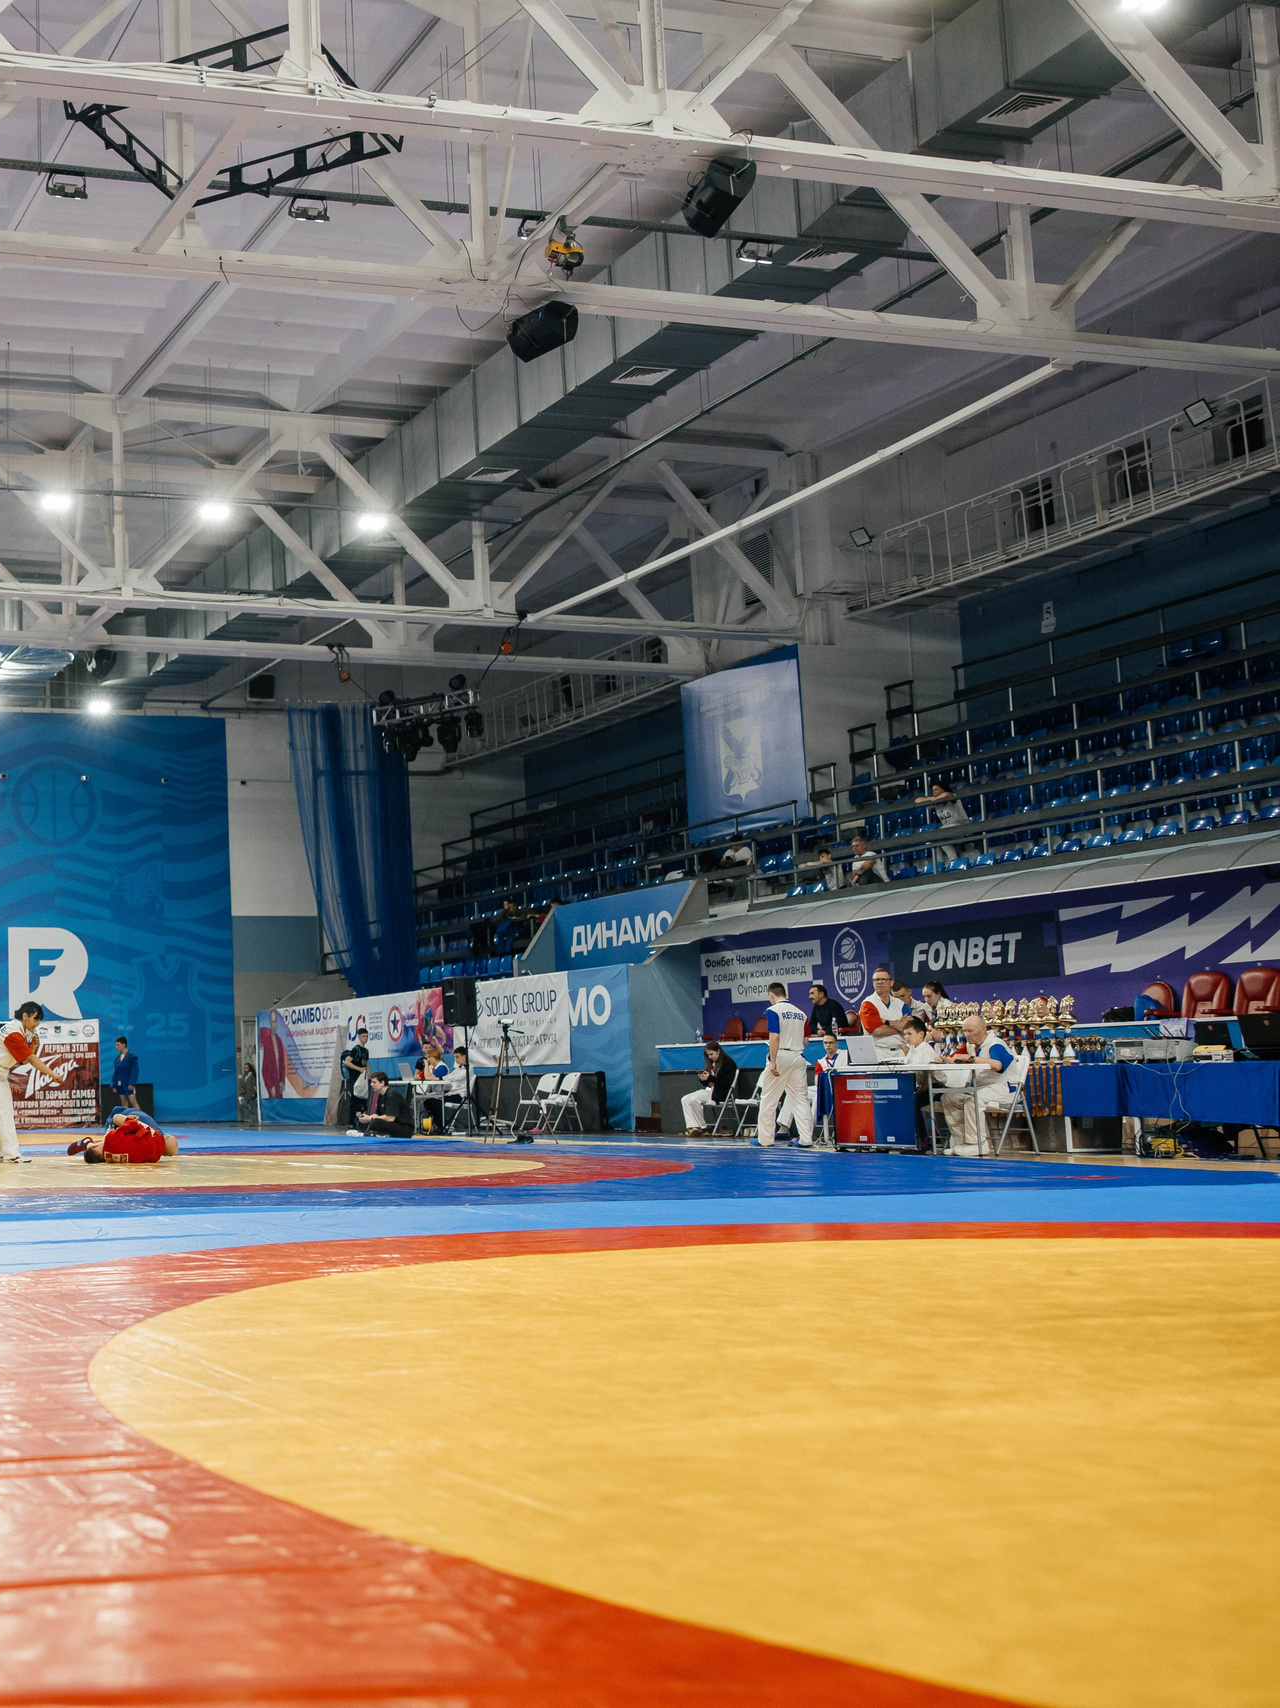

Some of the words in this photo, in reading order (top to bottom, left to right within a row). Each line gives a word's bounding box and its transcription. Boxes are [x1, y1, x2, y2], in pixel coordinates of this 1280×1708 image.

[571, 910, 674, 958] ДИНАМО
[705, 955, 735, 968] Фонбет
[735, 953, 780, 966] Чемпионат
[782, 948, 814, 961] России
[912, 932, 1022, 973] FONBET
[713, 971, 738, 983] среди
[739, 969, 773, 982] мужских
[775, 965, 807, 976] команд
[737, 984, 769, 997] Суперл
[485, 994, 518, 1017] SOLDIS
[522, 989, 557, 1013] GROUP
[290, 1006, 321, 1025] САМБО
[781, 1011, 805, 1021] REFEREE
[324, 1026, 337, 1034] СПОРТ
[369, 1031, 383, 1041] САМБО
[45, 1044, 70, 1053] ПЕРВЫЙ
[71, 1044, 88, 1052] ЭТАП
[865, 1081, 879, 1089] 02:33
[35, 1091, 44, 1100] ПО
[45, 1090, 70, 1099] БОРЬБЕ
[72, 1089, 96, 1098] САМБО
[13, 1100, 39, 1108] РНАТОРА
[39, 1099, 80, 1108] ПРИМОРСКОГО
[81, 1099, 96, 1107] КРАЯ
